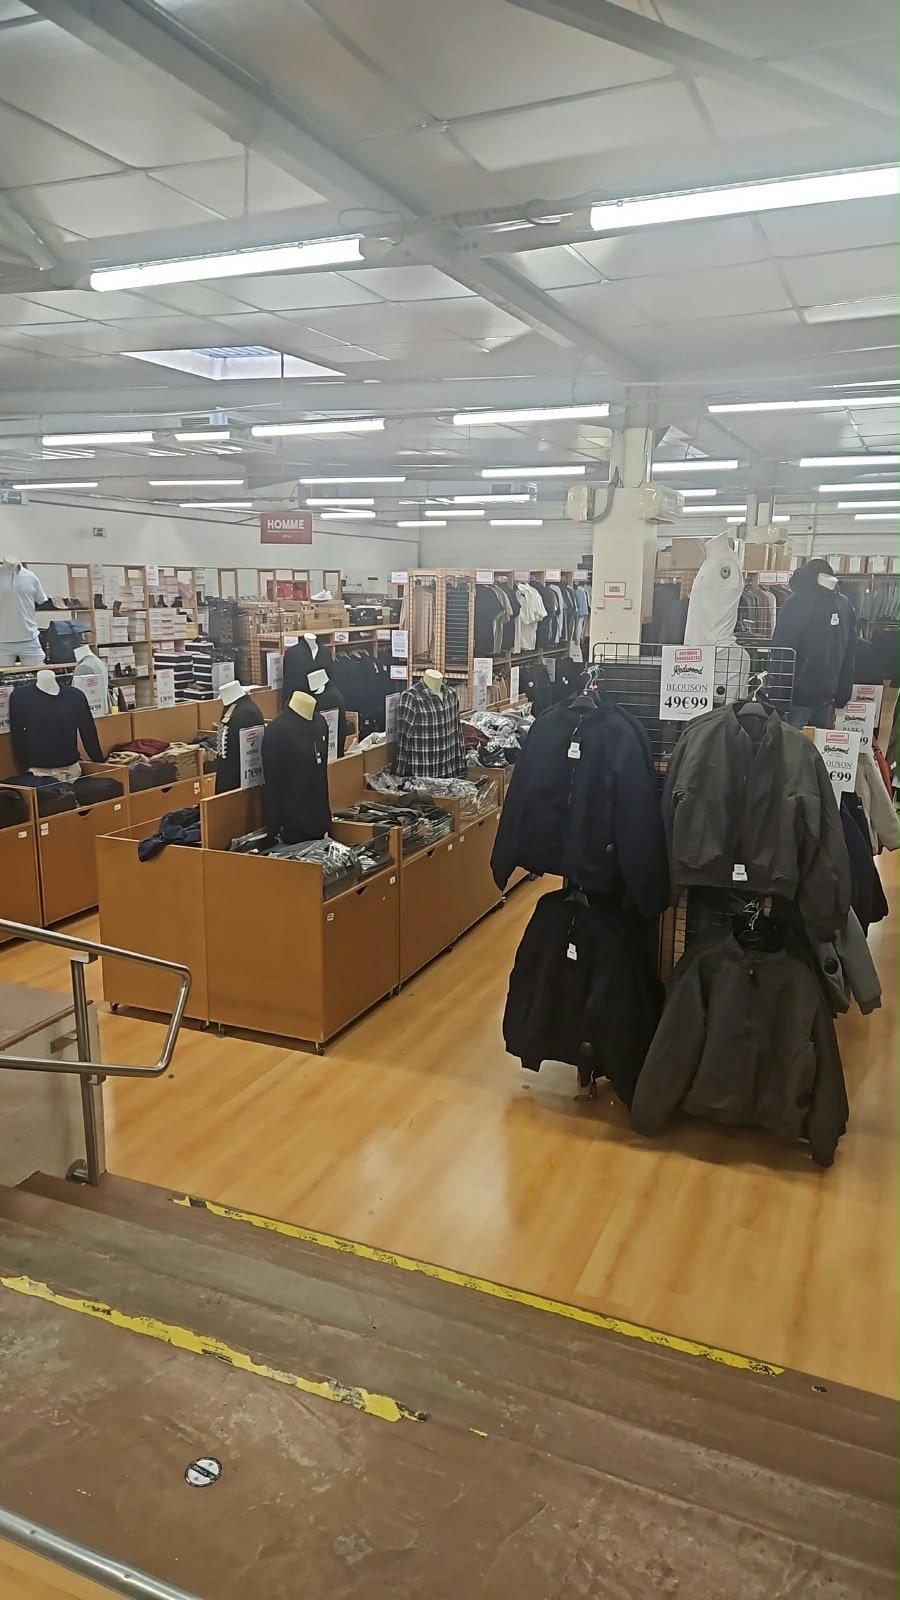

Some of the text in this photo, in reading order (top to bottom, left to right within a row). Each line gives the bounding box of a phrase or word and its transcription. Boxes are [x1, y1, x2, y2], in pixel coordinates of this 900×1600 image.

[267, 519, 305, 530] HOMME
[671, 664, 704, 677] Redwood
[666, 683, 708, 691] BLOUSON
[664, 696, 708, 710] 49€99
[825, 760, 853, 769] OUSON
